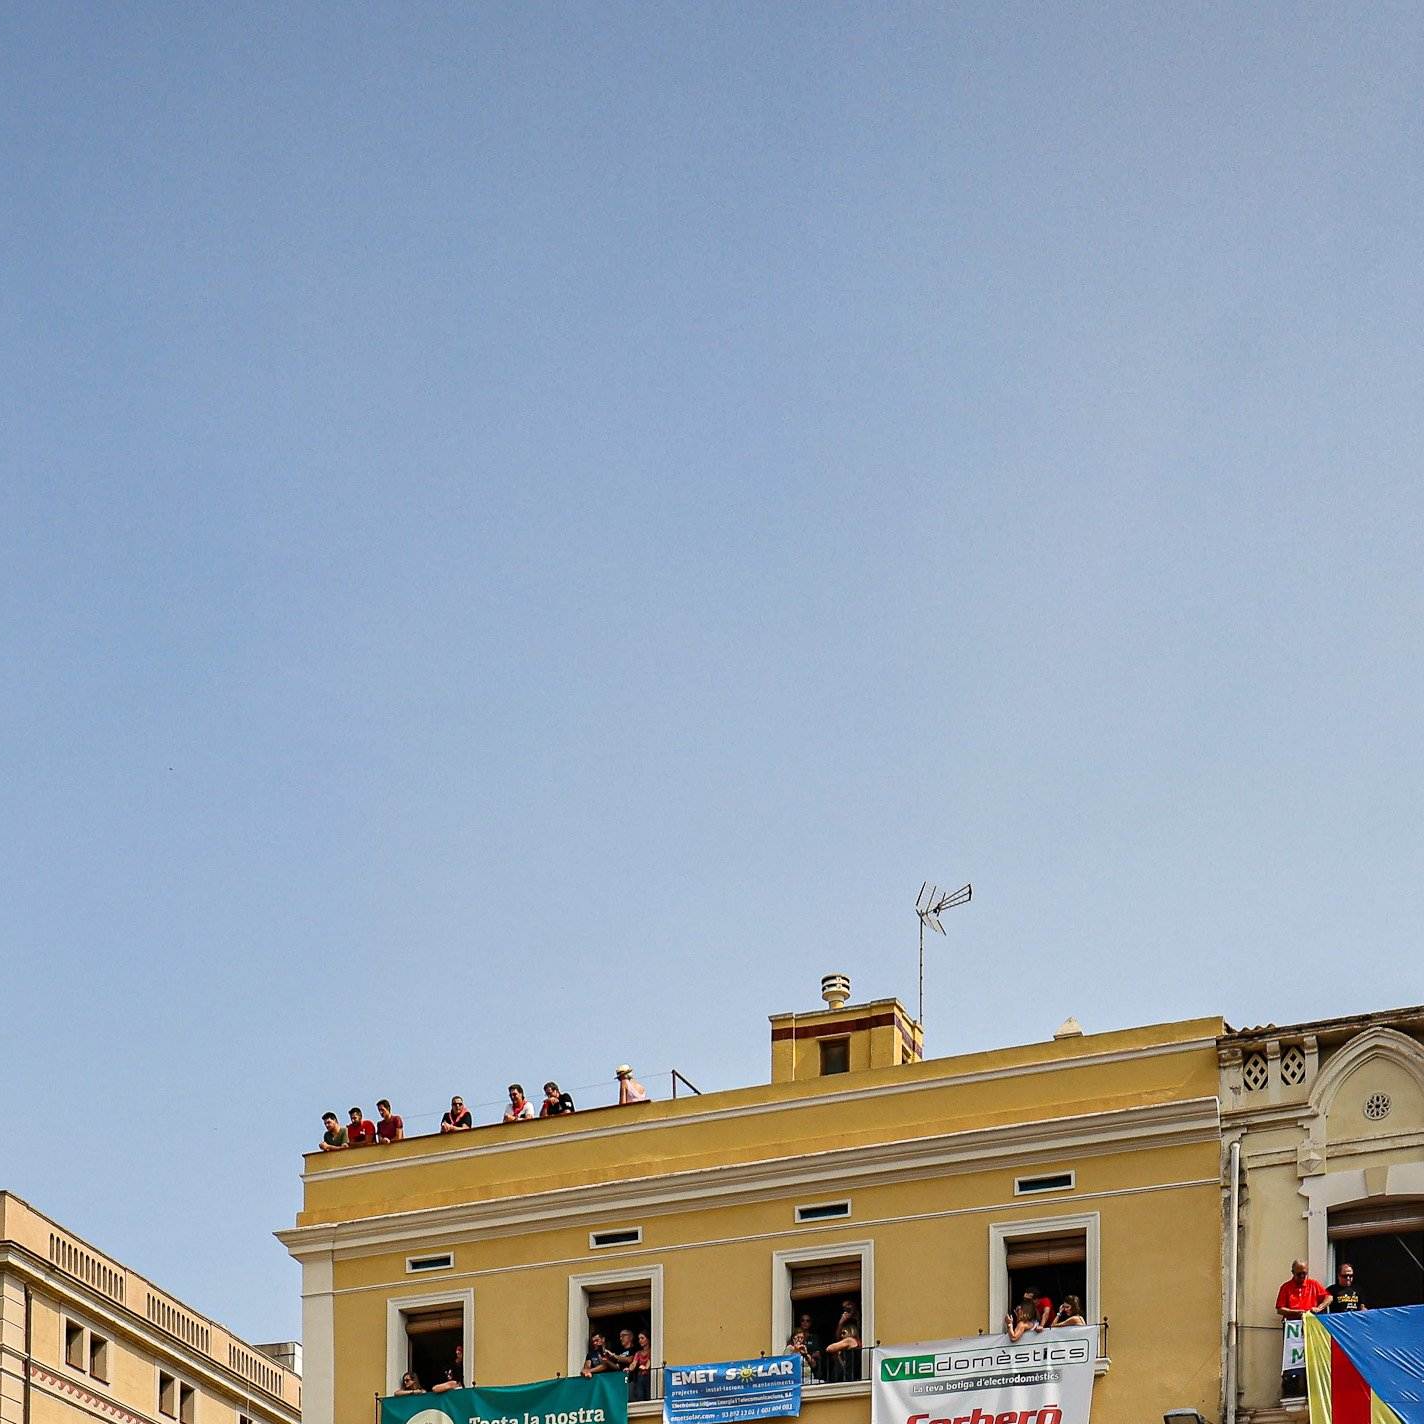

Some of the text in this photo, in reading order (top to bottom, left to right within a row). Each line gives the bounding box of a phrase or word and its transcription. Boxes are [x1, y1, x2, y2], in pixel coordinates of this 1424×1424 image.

[885, 1346, 1086, 1377] Viladomèstics
[672, 1361, 794, 1386] EMET SOLAR
[672, 1389, 699, 1397] projectes
[913, 1385, 923, 1393] La
[925, 1383, 944, 1393] teva
[946, 1379, 975, 1392] botiga
